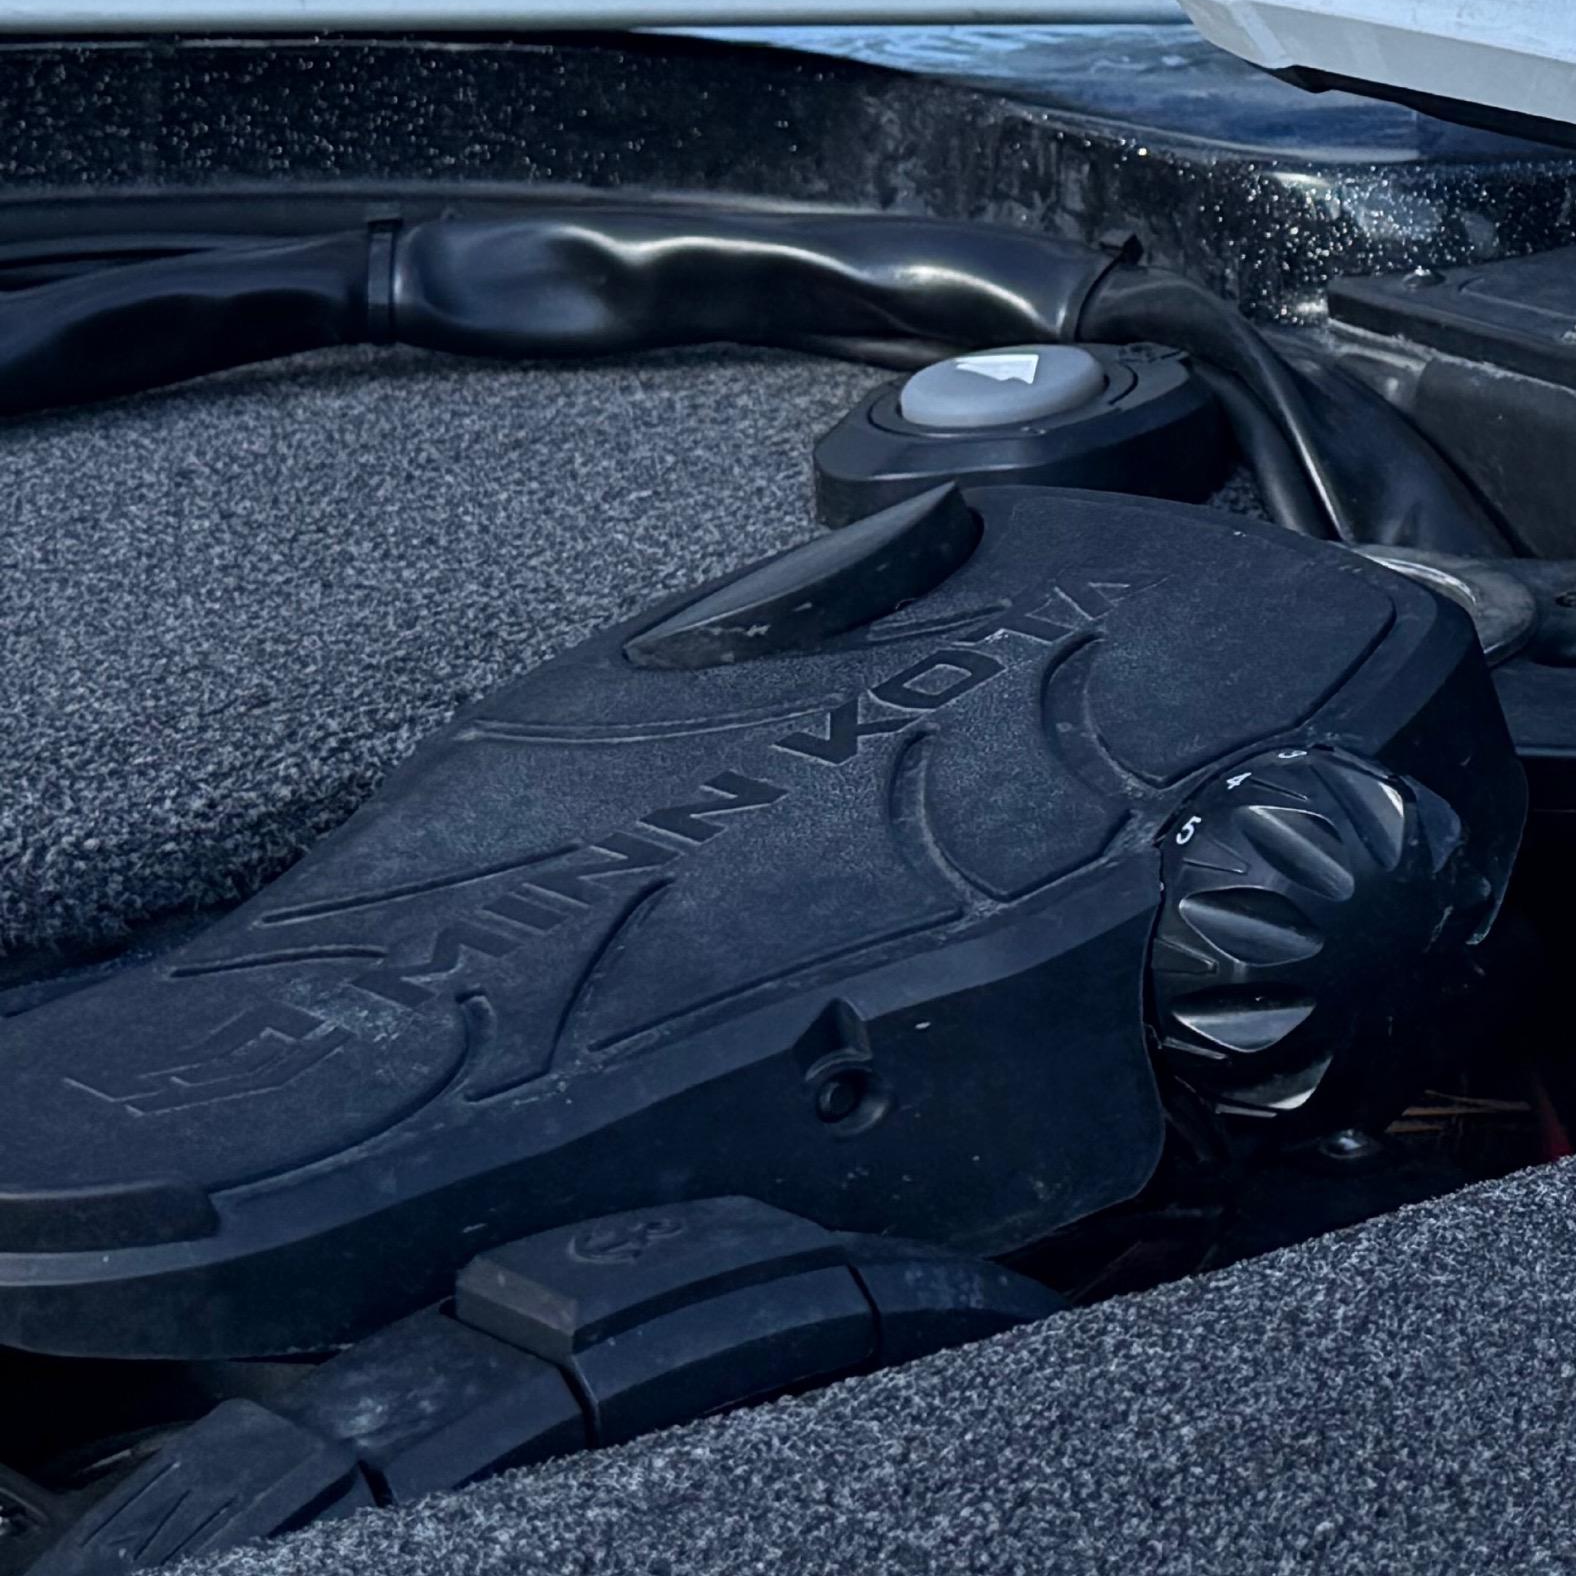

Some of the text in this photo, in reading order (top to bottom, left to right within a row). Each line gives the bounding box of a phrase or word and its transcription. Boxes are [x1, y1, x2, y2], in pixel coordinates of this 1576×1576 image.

[346, 567, 1173, 1008] MINN KOTA
[1226, 772, 1251, 791] 4
[1176, 815, 1201, 845] 5
